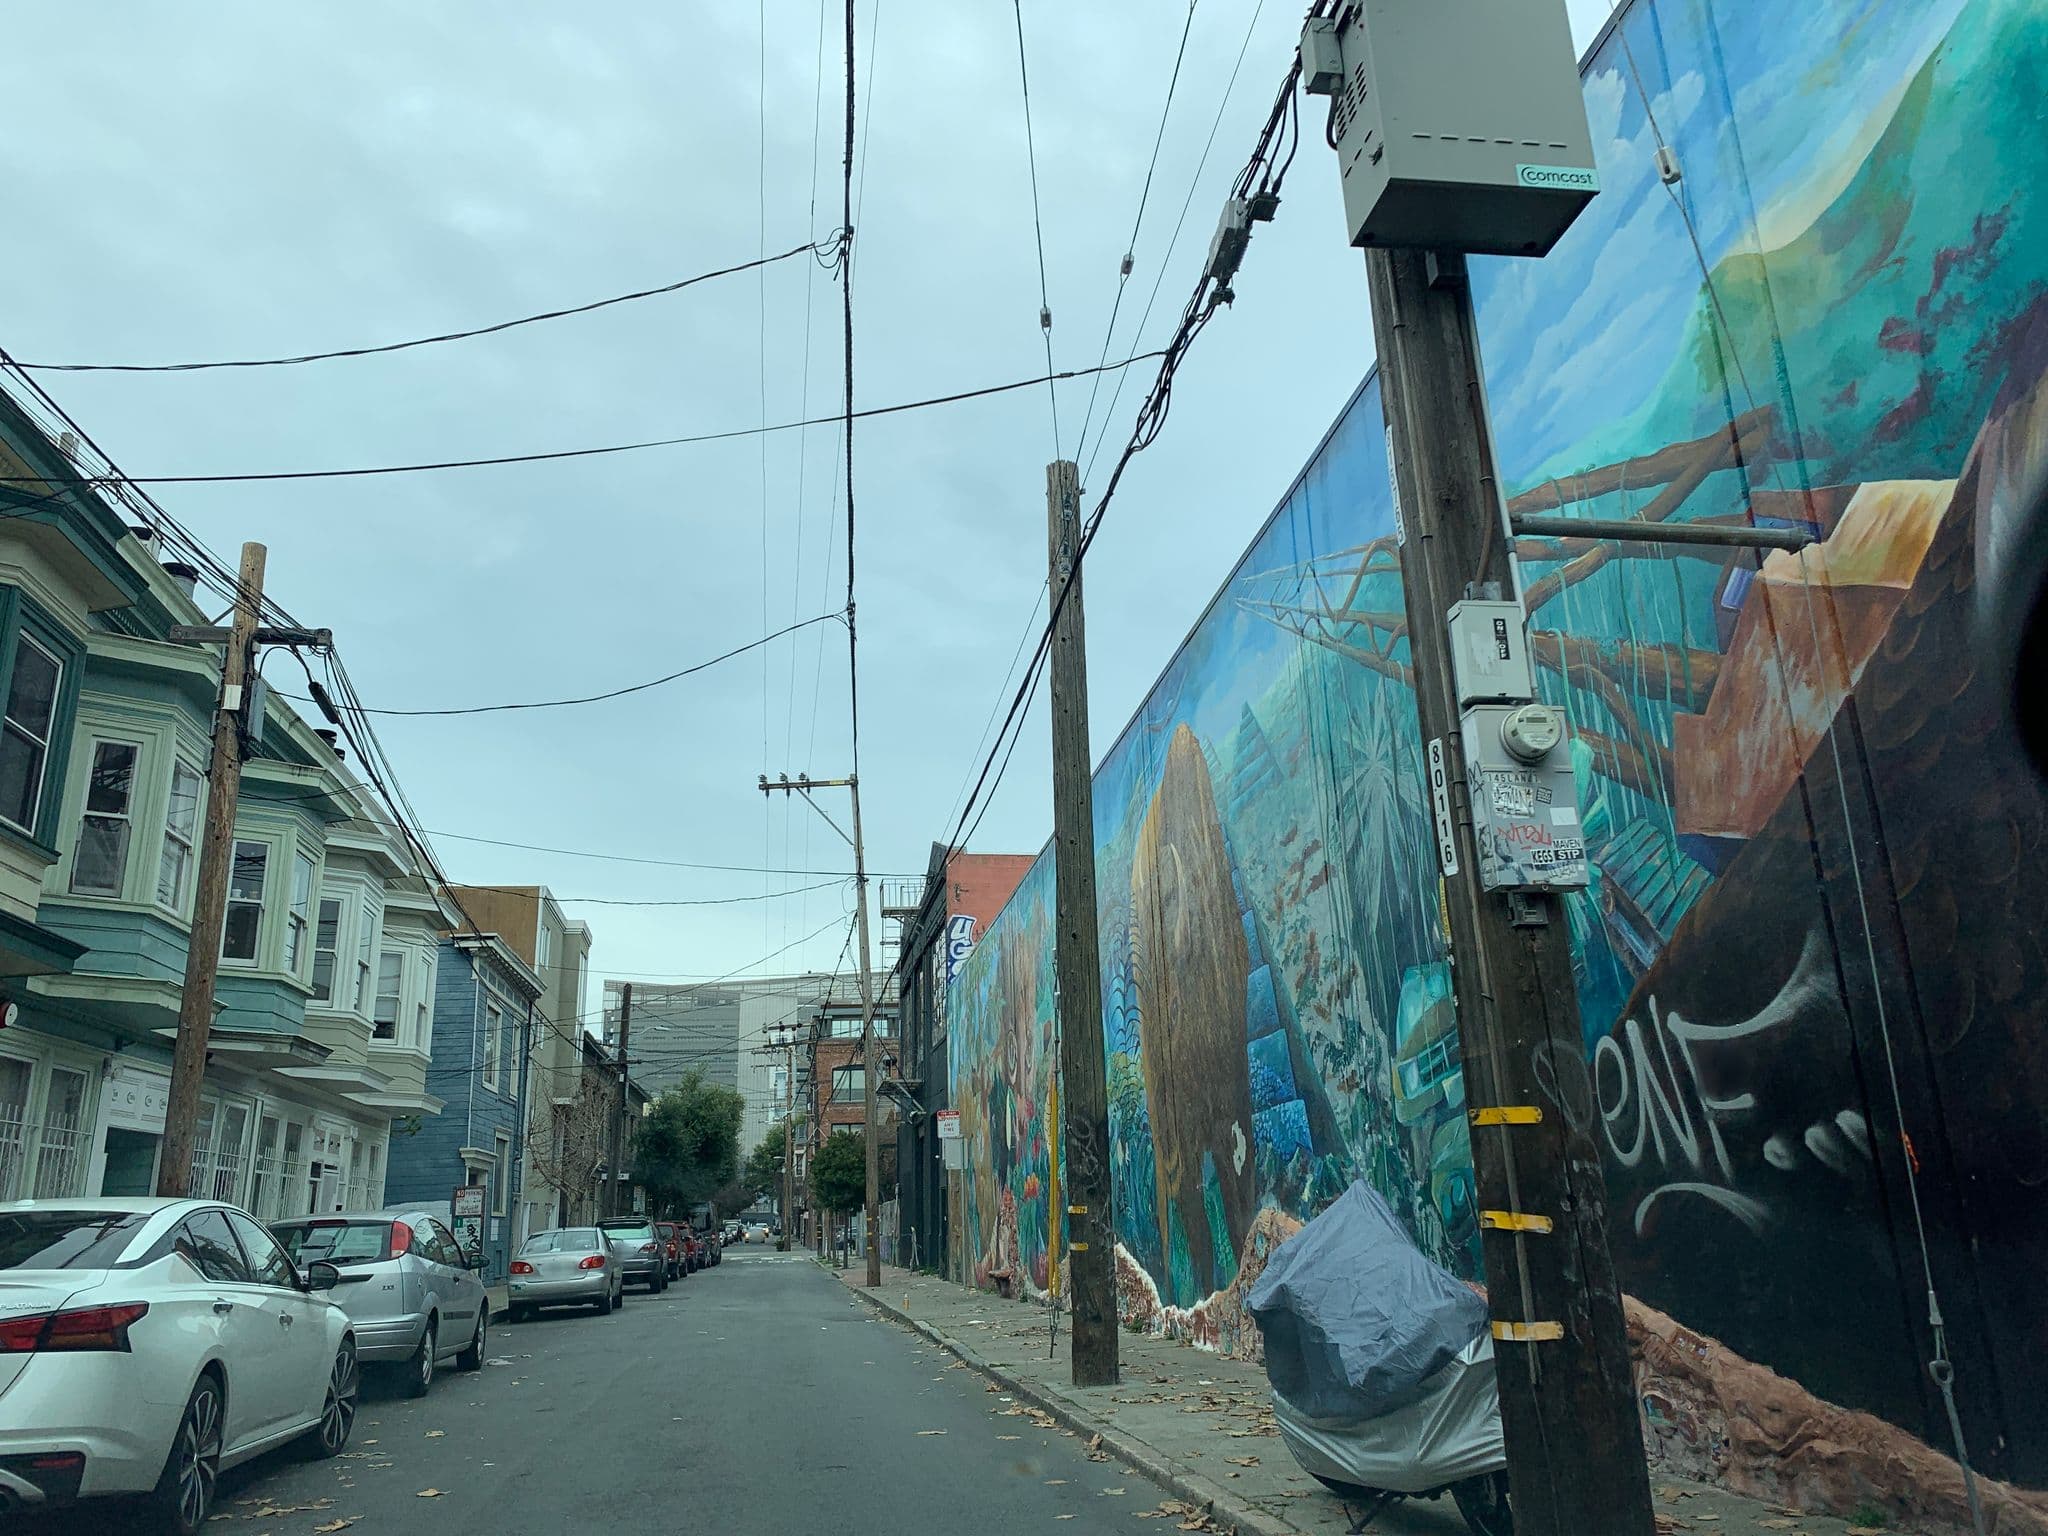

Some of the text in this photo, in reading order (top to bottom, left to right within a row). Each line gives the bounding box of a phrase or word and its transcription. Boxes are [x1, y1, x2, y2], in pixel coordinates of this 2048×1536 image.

[1553, 840, 1580, 849] MAVEN
[1531, 850, 1554, 863] KEGS
[1558, 849, 1580, 860] STP
